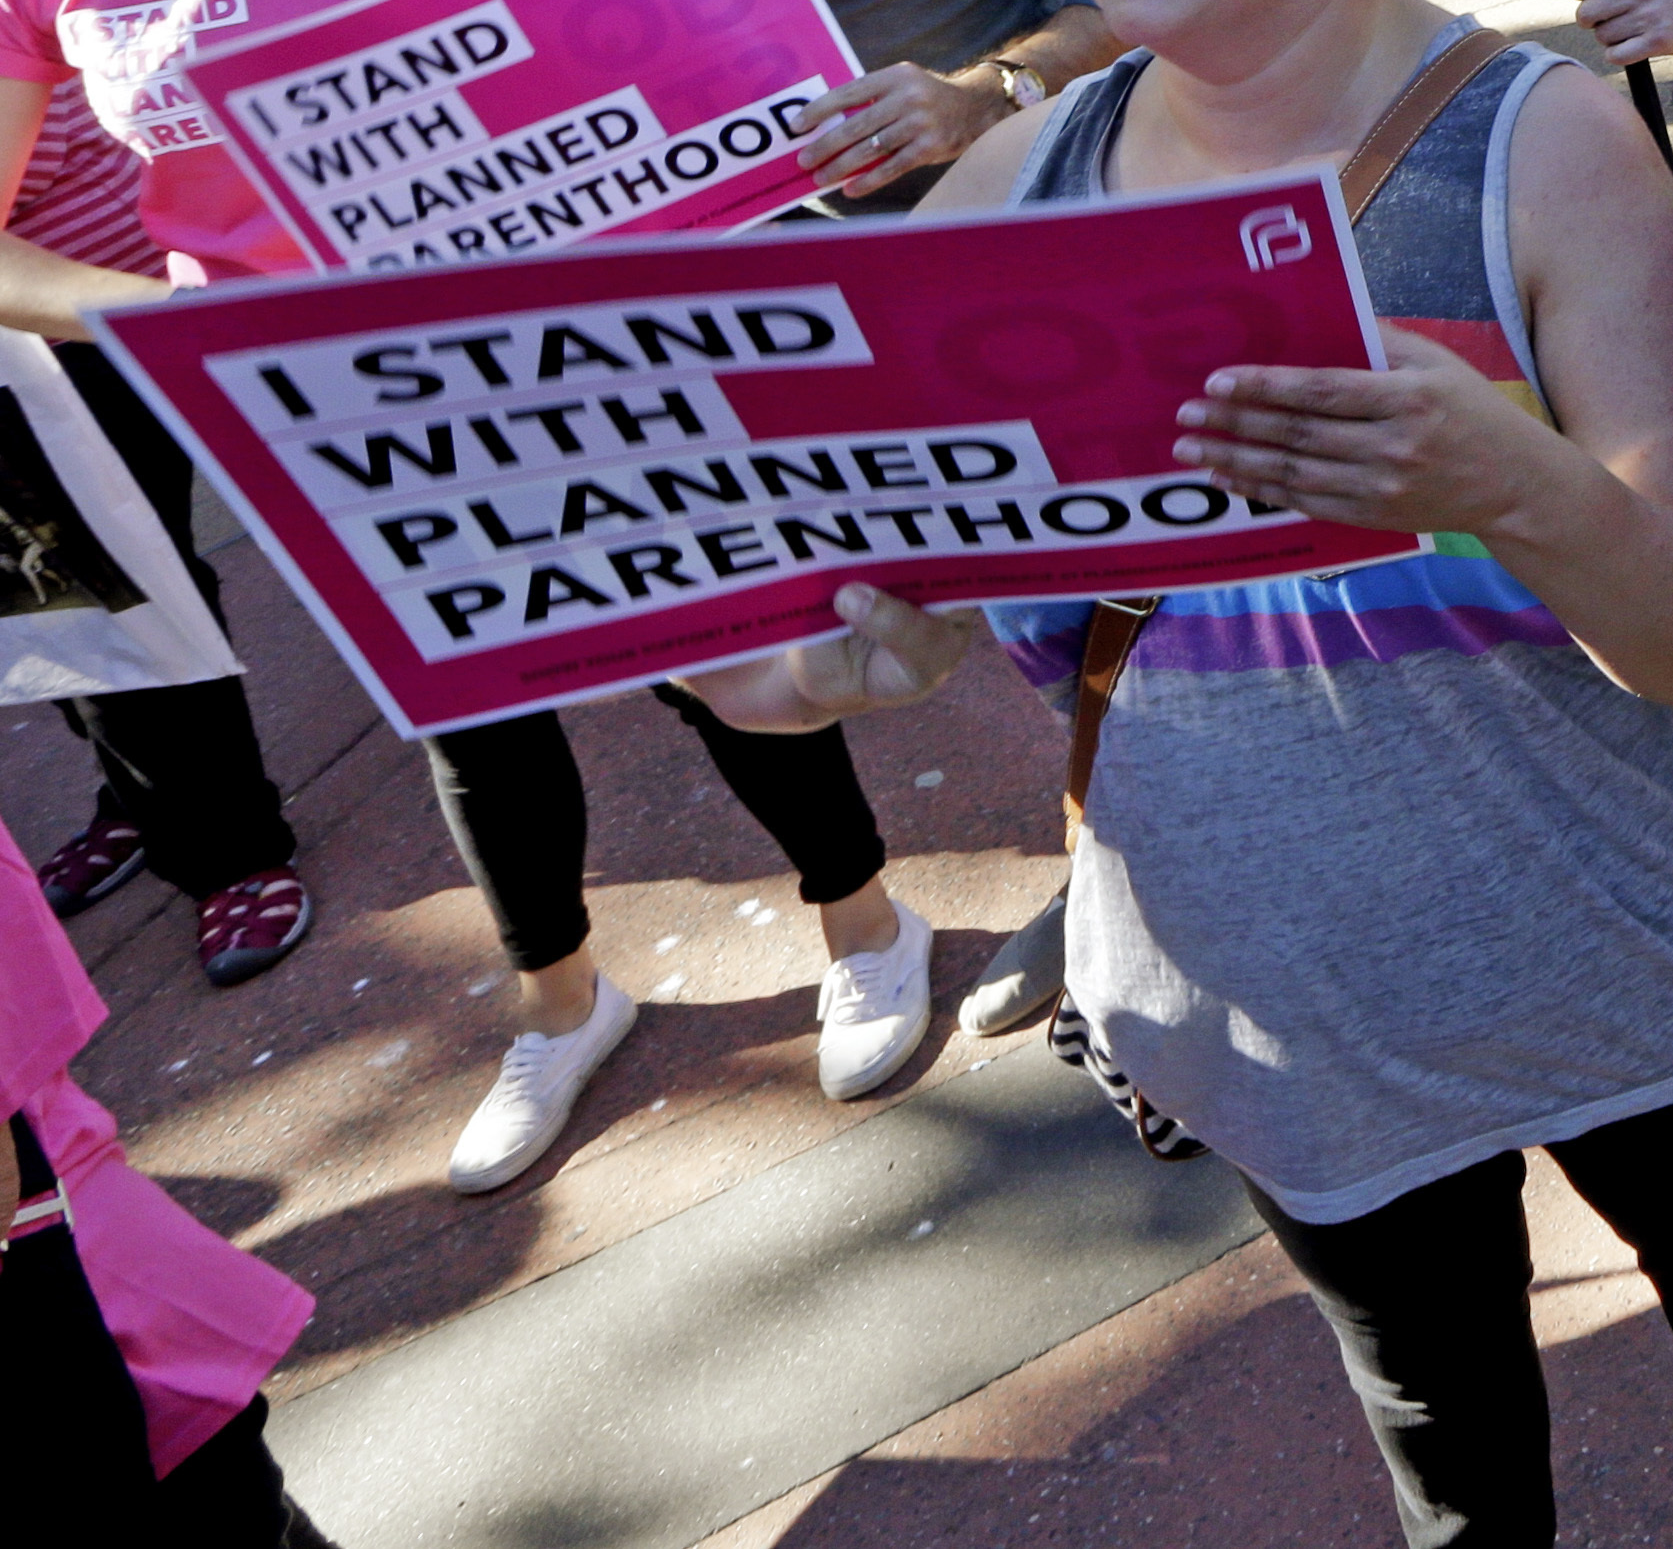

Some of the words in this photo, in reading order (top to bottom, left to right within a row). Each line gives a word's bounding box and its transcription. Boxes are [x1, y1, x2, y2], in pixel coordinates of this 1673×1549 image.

[246, 97, 280, 139] I
[286, 19, 509, 129] STAND
[284, 101, 464, 187] WITH
[331, 106, 639, 244] PLANNED
[258, 363, 316, 417] I
[354, 303, 837, 406] STAND
[306, 387, 705, 493] WITH
[372, 429, 1018, 571] PLANNED
